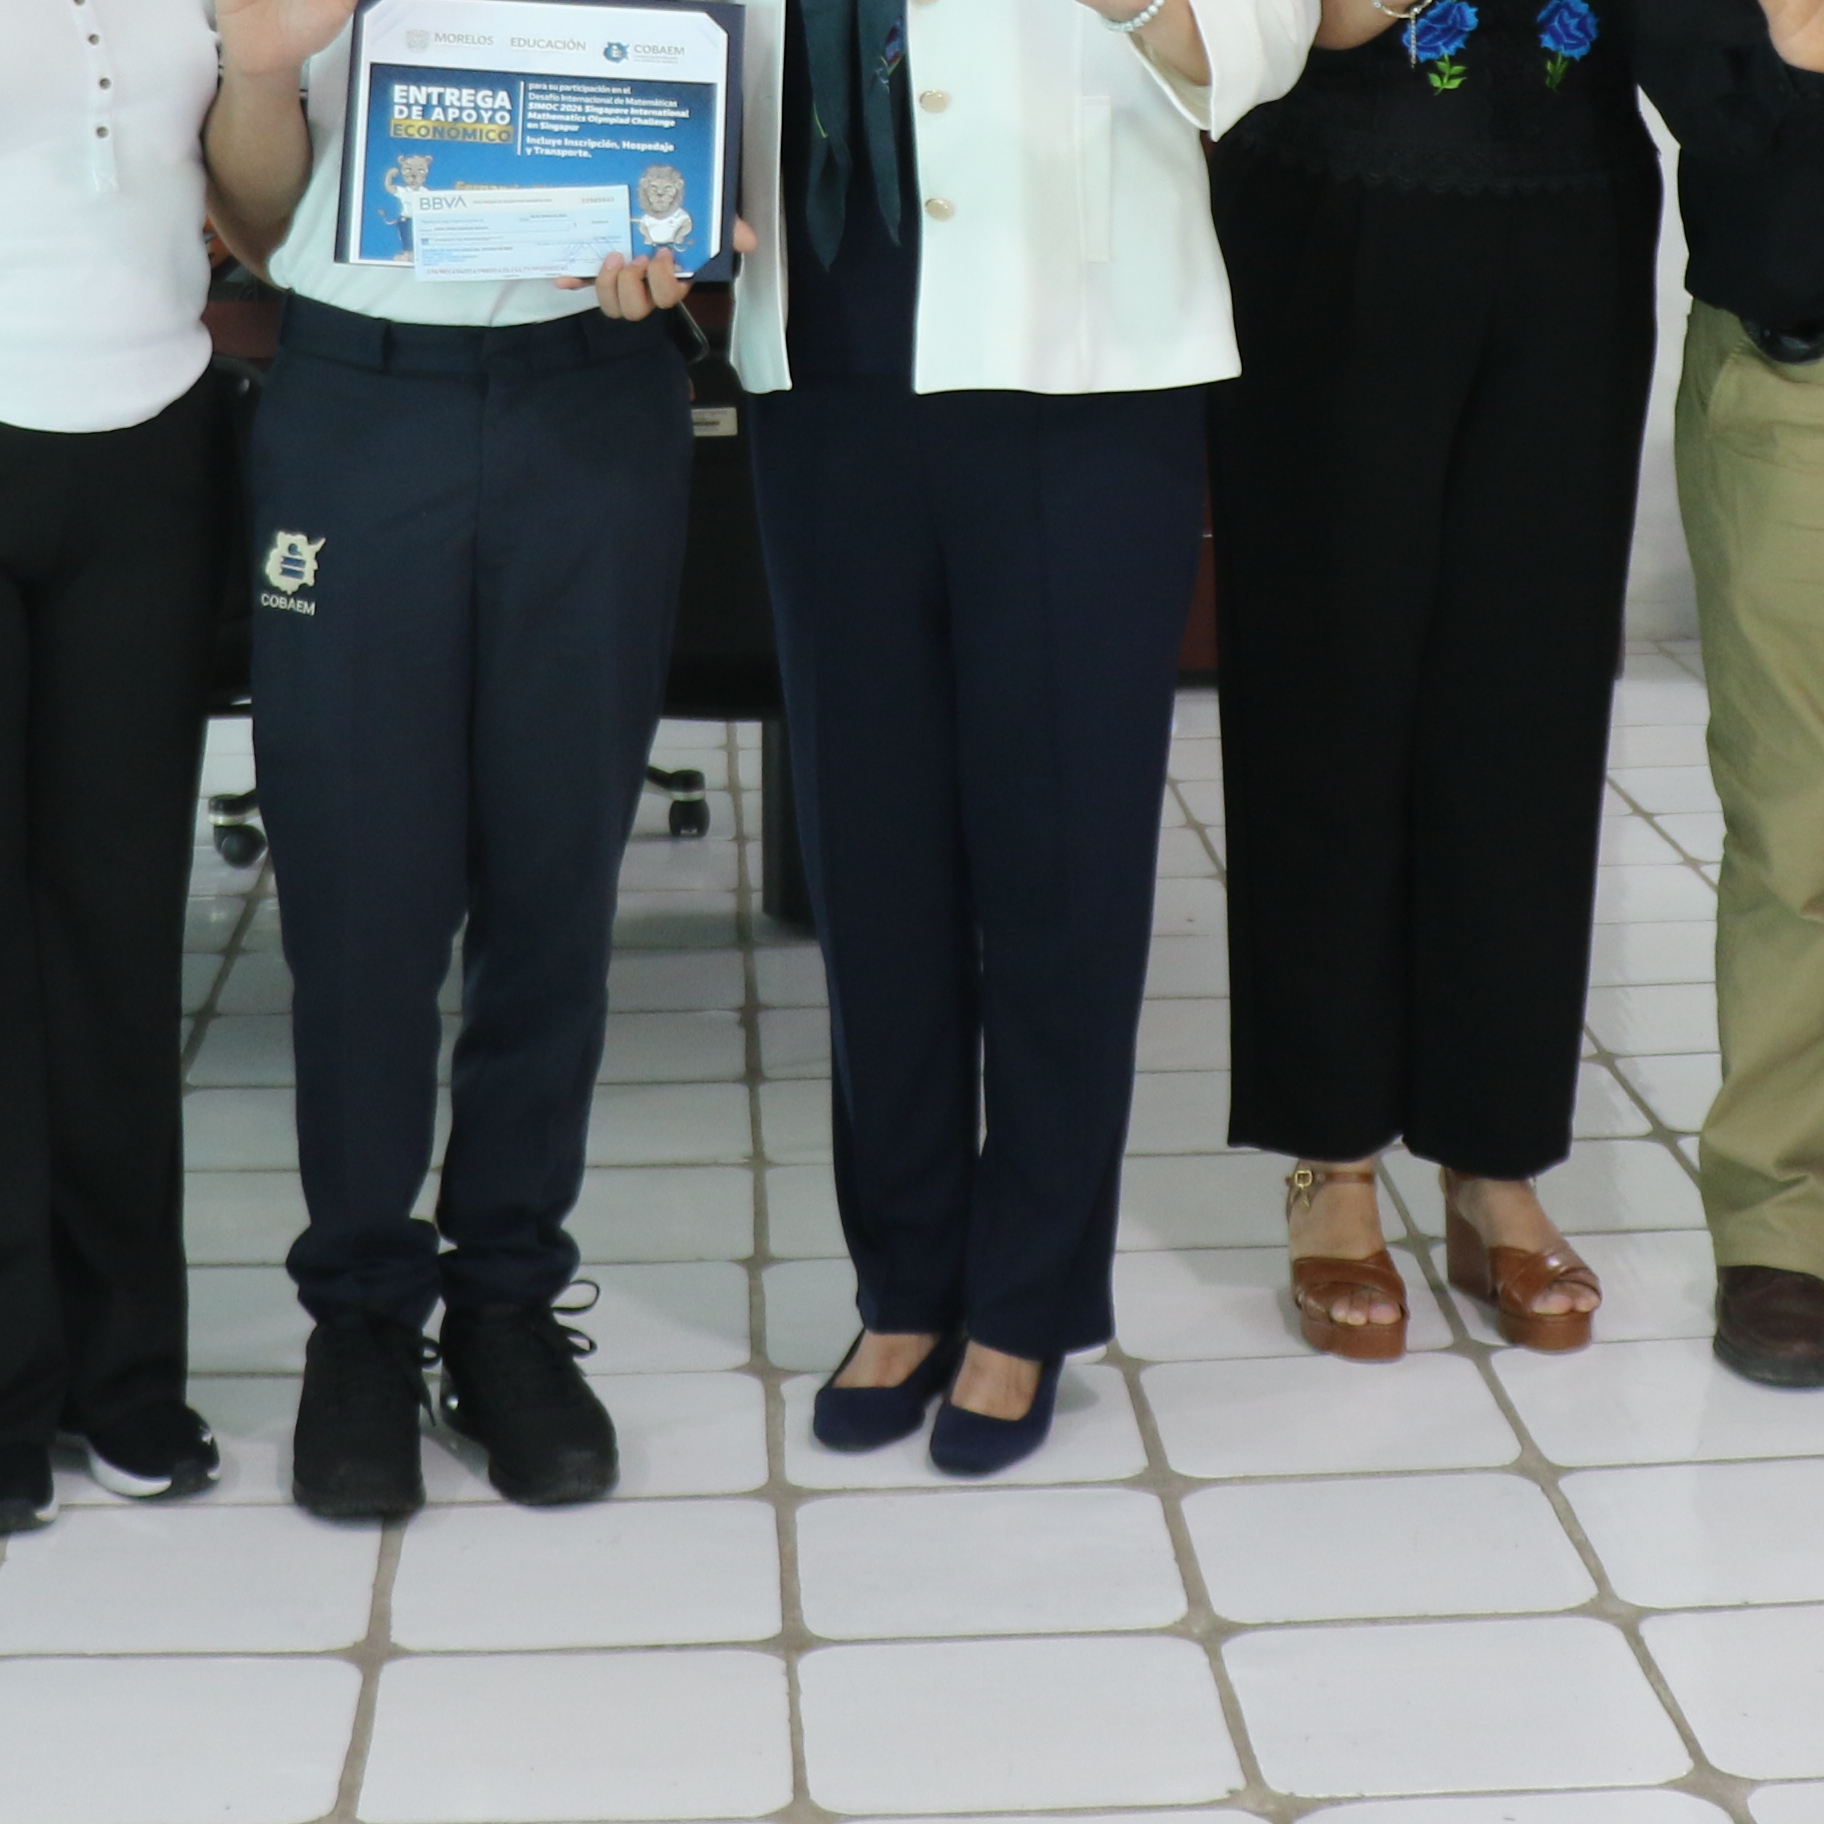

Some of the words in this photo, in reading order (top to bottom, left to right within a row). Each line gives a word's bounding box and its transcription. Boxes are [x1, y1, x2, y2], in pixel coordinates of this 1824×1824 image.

[434, 33, 494, 46] MORELOS
[510, 36, 587, 51] EDUCACIÓN
[633, 44, 685, 56] COBAEM
[528, 83, 547, 92] para
[559, 83, 611, 94] participación
[623, 86, 632, 94] el
[393, 84, 512, 110] ENTREGA
[561, 94, 613, 105] Internacional
[614, 96, 624, 105] de
[625, 97, 678, 107] Matemáticas
[393, 105, 423, 120] DE
[431, 107, 511, 125] APOYO
[528, 102, 559, 111] SIMOC
[584, 105, 629, 115] Singapore
[630, 107, 690, 118] International
[527, 112, 586, 123] Mathematics
[587, 115, 630, 125] Olympiad
[631, 117, 676, 128] Challenge
[527, 122, 539, 130] en
[540, 122, 580, 132] Singapur
[526, 136, 563, 146] Incluye
[622, 141, 675, 153] Hospedaje
[419, 195, 467, 210] BBVA
[261, 592, 315, 616] COBAEM
